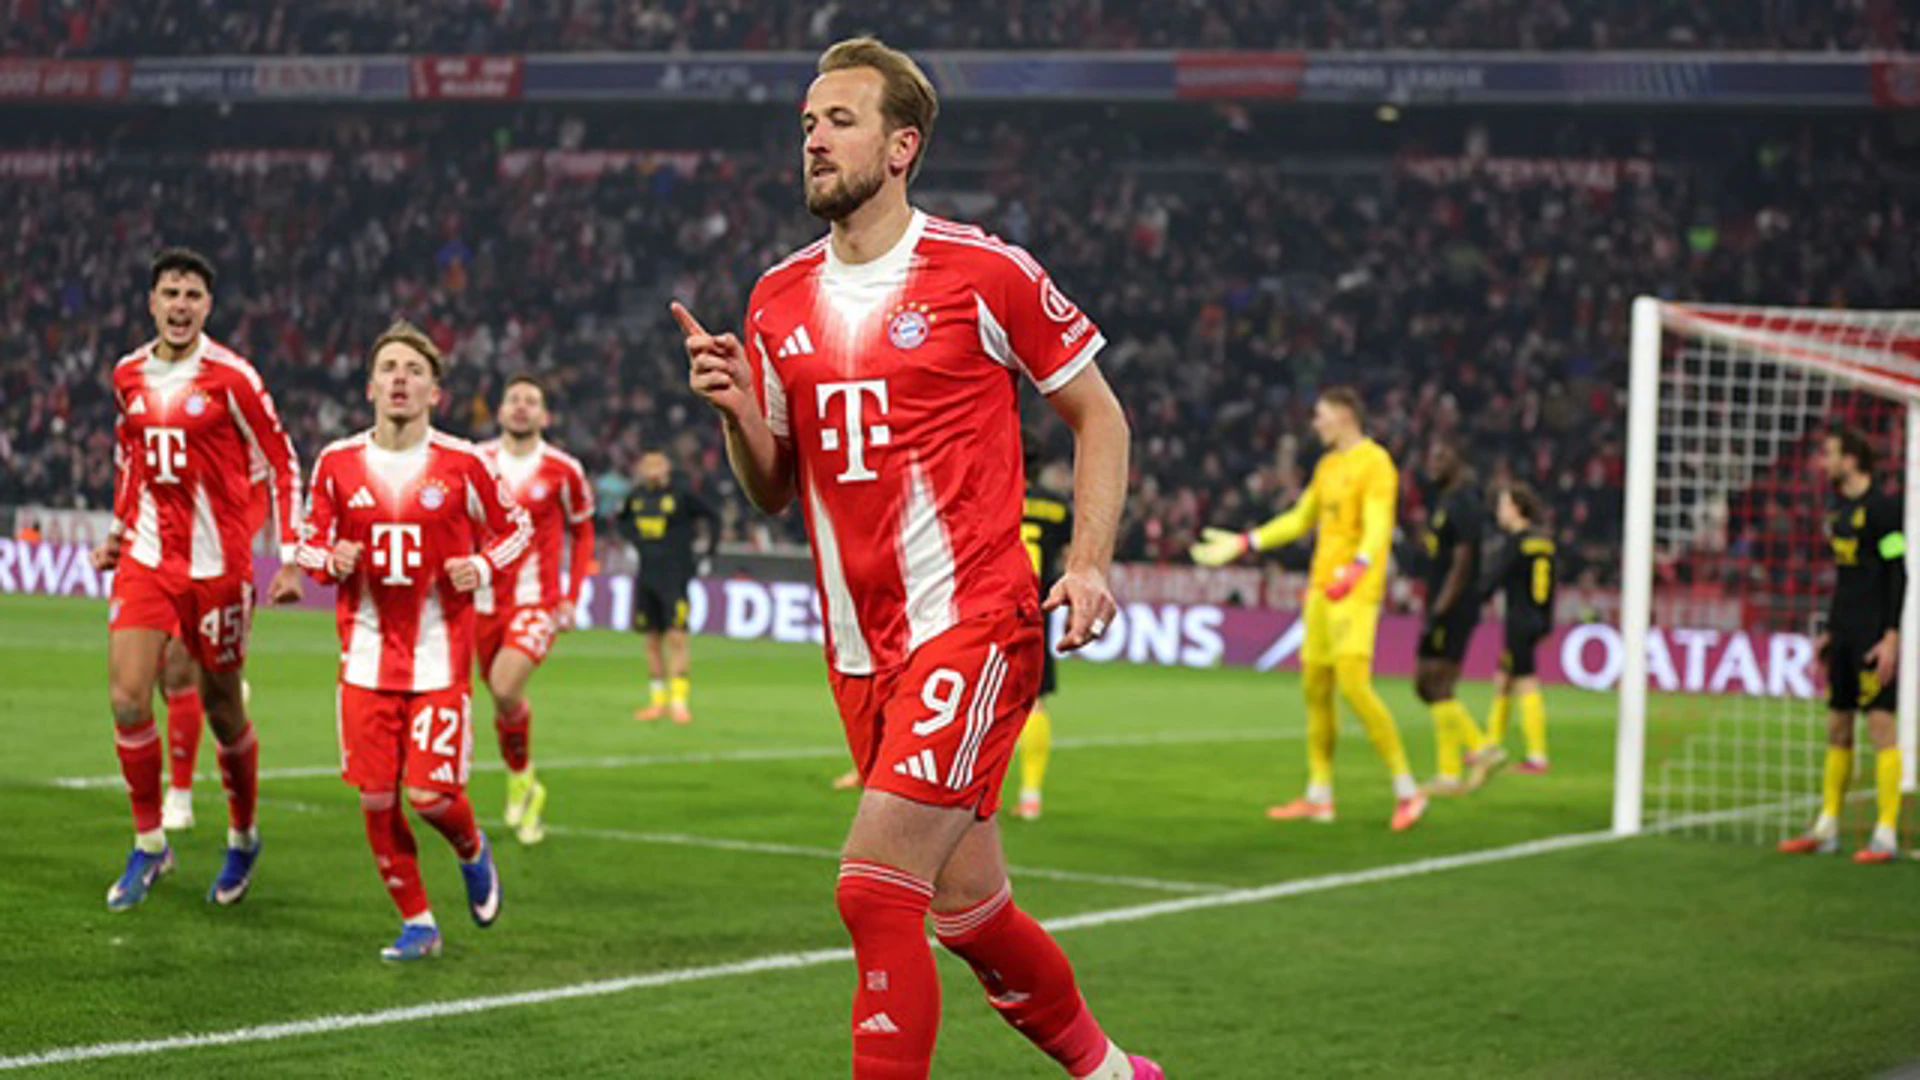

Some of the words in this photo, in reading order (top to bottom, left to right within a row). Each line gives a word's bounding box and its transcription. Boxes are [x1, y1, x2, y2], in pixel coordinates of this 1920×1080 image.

[201, 606, 242, 645] 45
[911, 668, 966, 736] 9
[411, 704, 459, 756] 42
